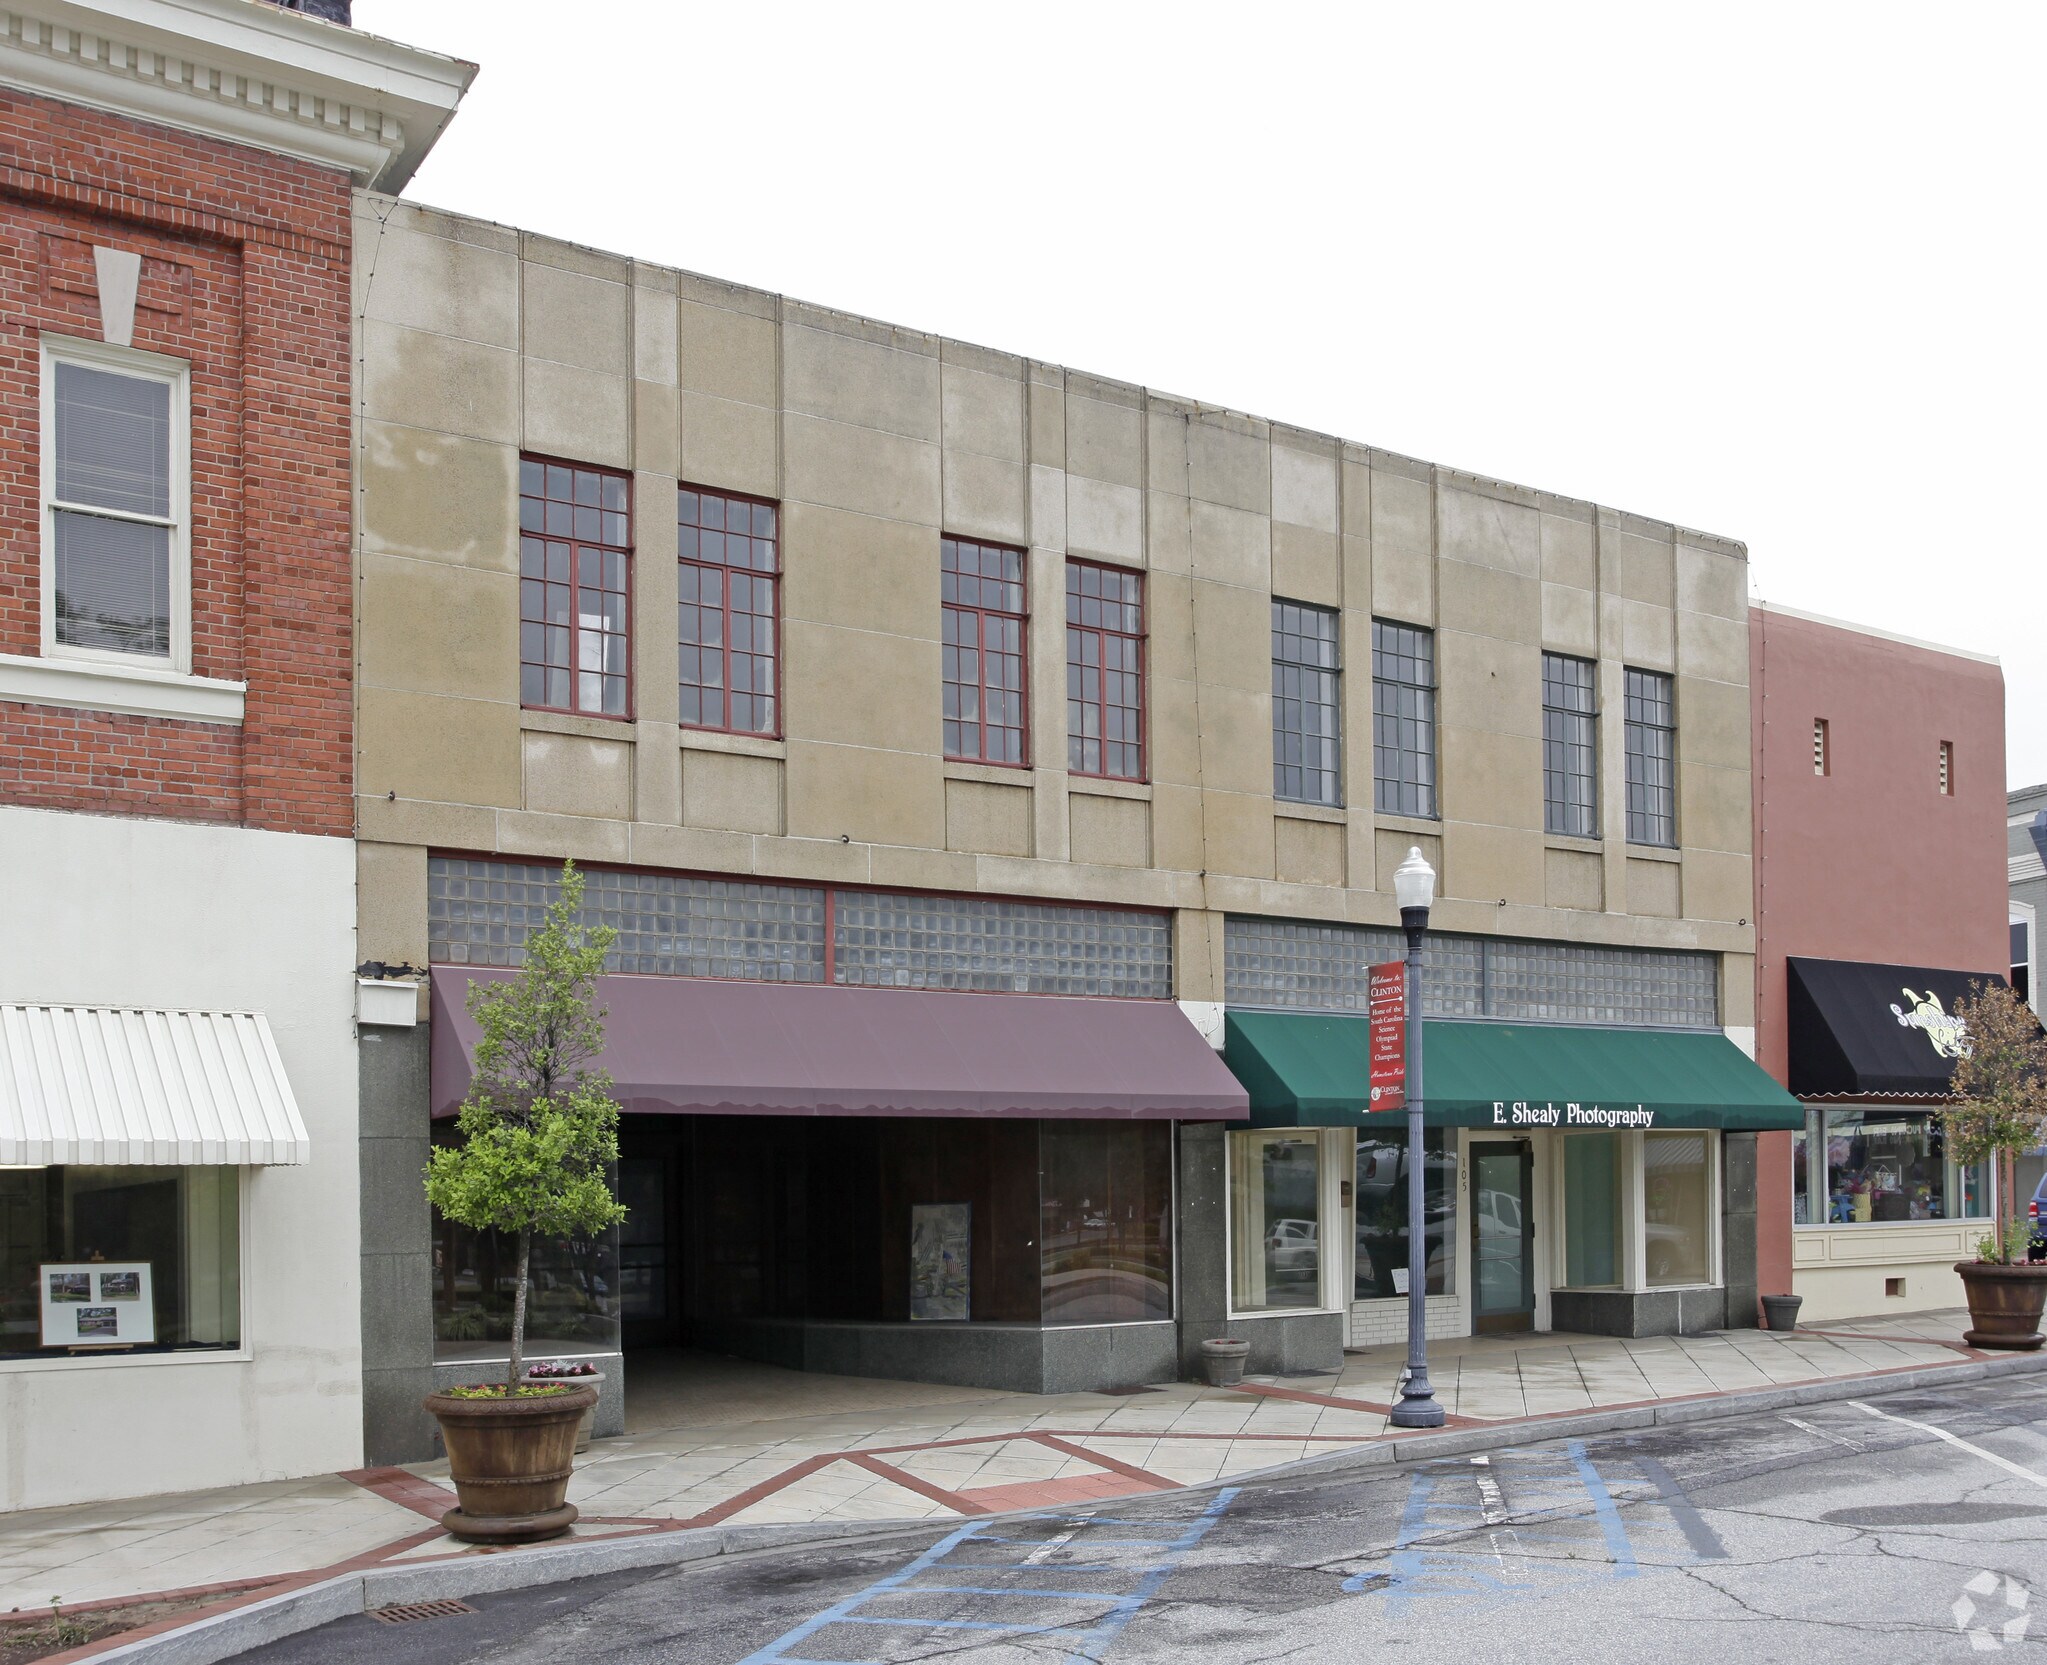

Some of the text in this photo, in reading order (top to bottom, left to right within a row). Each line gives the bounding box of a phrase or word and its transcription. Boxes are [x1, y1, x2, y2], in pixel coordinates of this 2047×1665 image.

[1371, 986, 1402, 997] CLINTON
[1493, 1102, 1654, 1128] E. Shealy Photography
